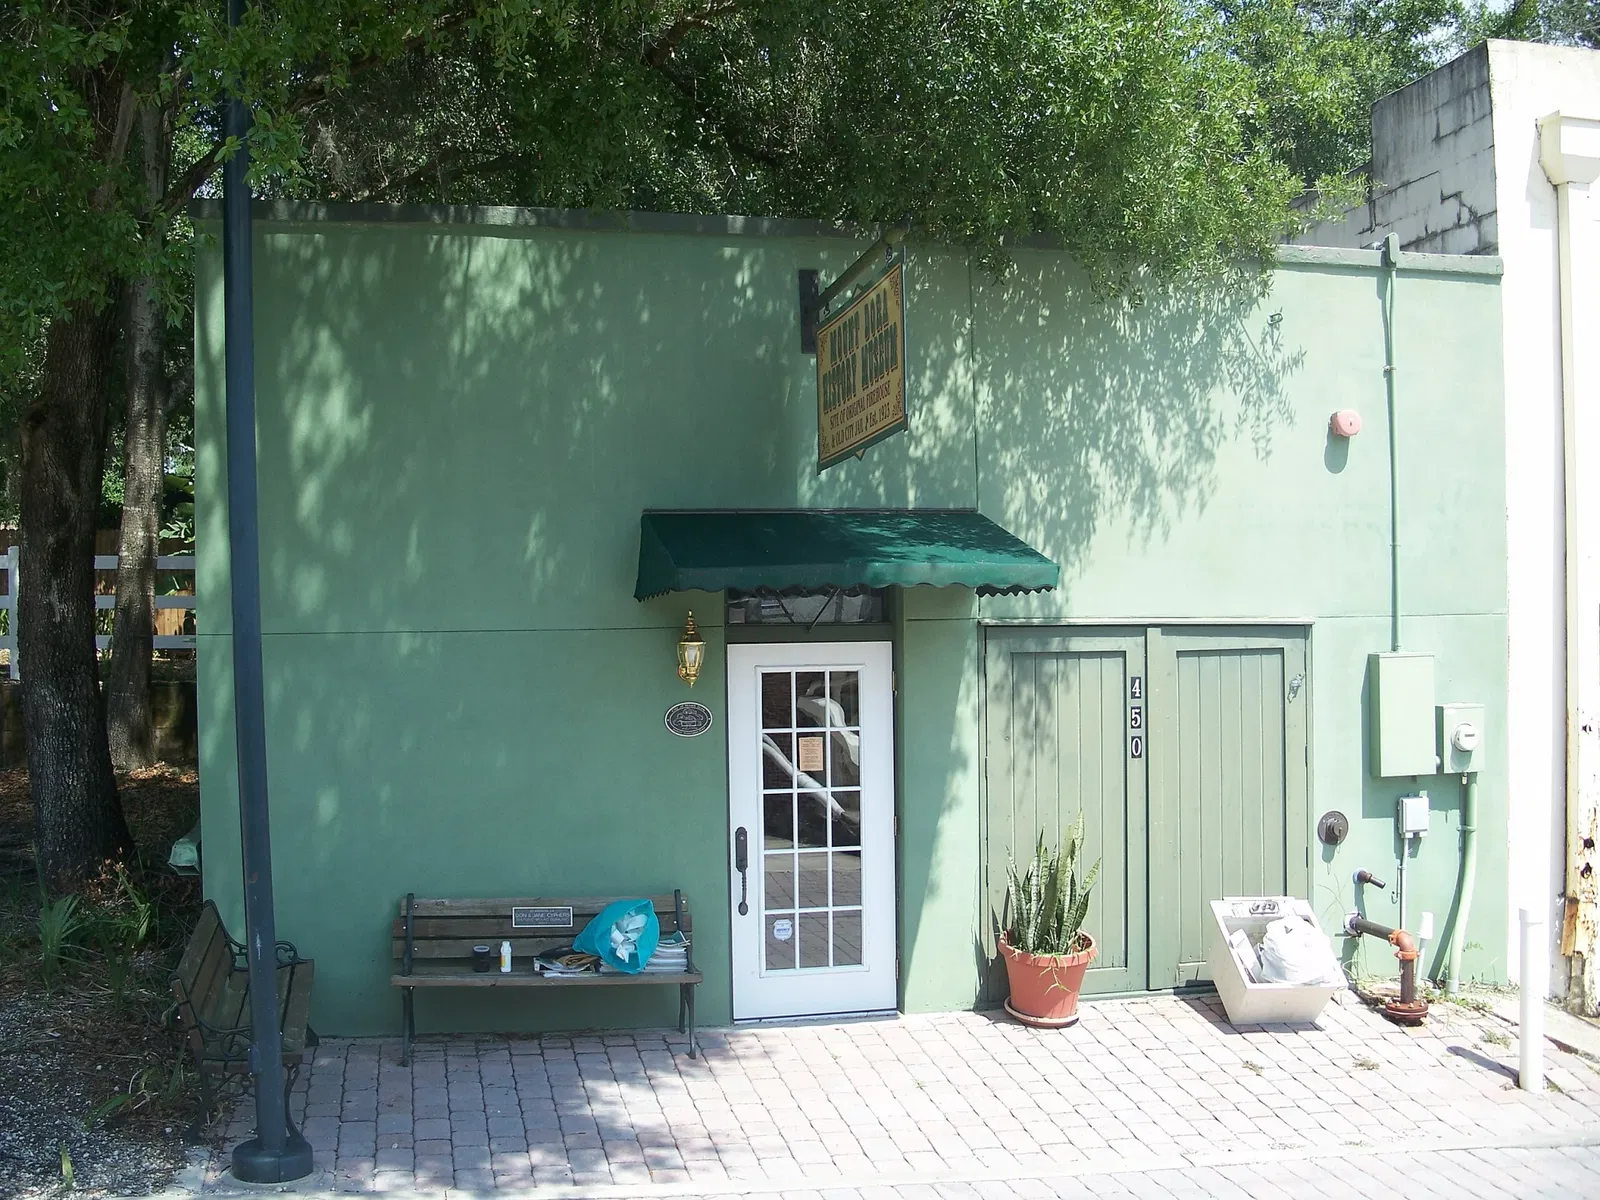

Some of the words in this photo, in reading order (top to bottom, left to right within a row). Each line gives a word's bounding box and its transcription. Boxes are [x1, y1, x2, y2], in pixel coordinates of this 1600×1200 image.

[830, 310, 860, 368] MOUNT
[864, 287, 890, 341] DORA
[822, 352, 857, 415] HISTORY
[861, 321, 898, 392] MUSEUM
[830, 412, 840, 430] SITE
[839, 408, 846, 425] OF
[845, 396, 866, 421] ORIGINAL
[866, 379, 891, 409] FIREHOUSE
[835, 429, 844, 446] OLD
[844, 422, 854, 442] CITY
[1131, 678, 1142, 756] 450
